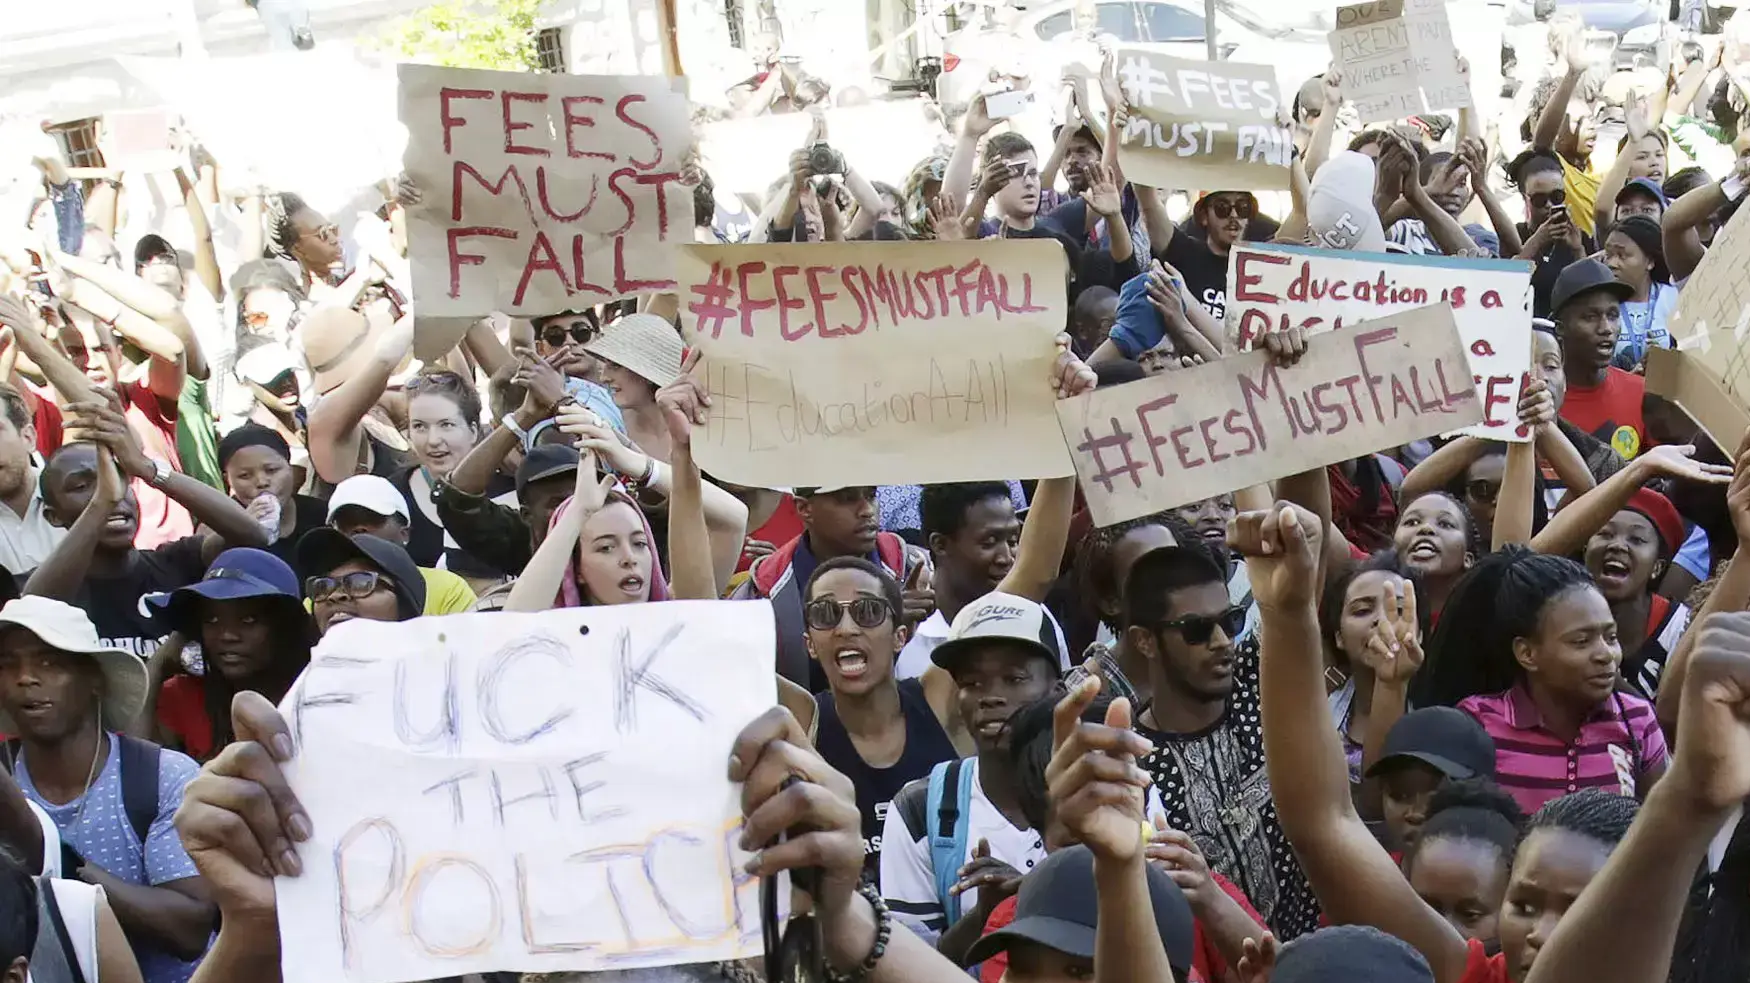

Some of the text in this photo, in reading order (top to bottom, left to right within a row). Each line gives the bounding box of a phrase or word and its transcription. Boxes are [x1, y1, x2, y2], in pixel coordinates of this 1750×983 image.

[1119, 56, 1278, 119] #FEES
[440, 87, 663, 171] FEES
[1120, 115, 1228, 157] MUST
[451, 160, 682, 241] MUST
[447, 227, 679, 307] FALL
[688, 259, 1048, 341] #FEESMUSTFALL
[1235, 252, 1504, 309] Education is a
[1470, 339, 1496, 357] a
[294, 622, 712, 756] FUCK
[422, 752, 631, 829] THE
